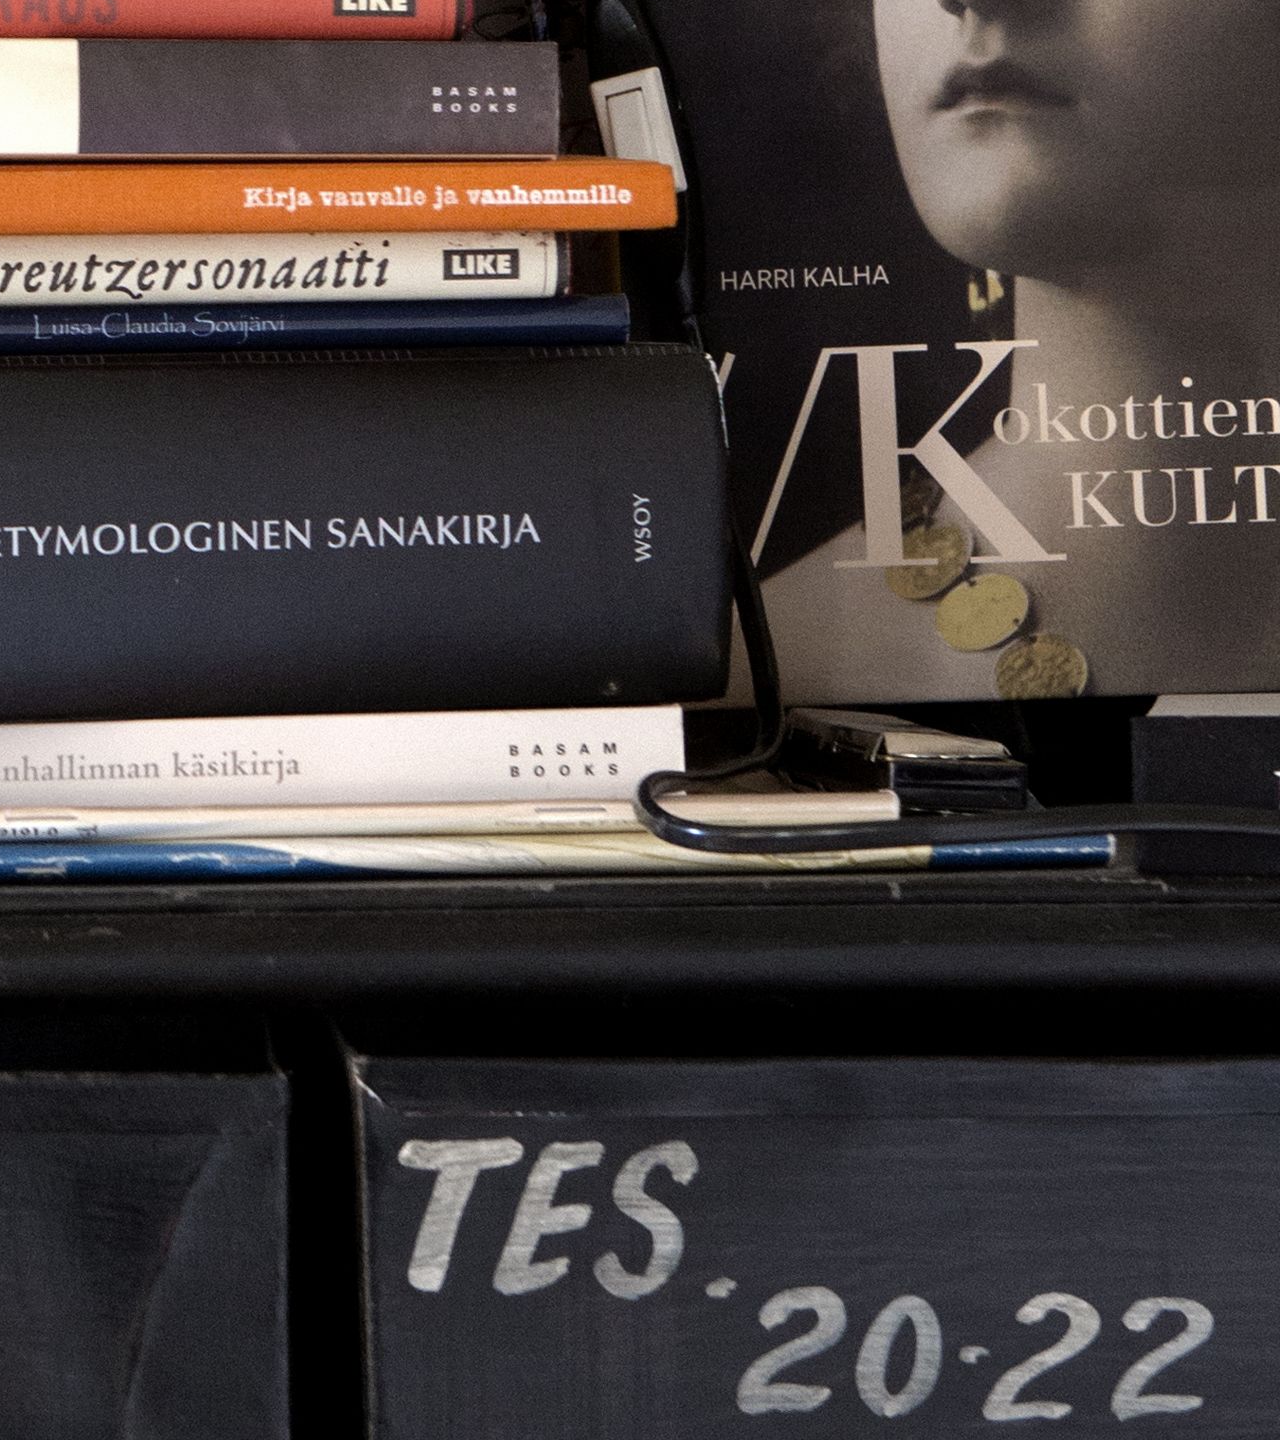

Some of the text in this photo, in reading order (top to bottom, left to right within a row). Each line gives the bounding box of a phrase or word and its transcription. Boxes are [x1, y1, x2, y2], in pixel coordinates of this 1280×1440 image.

[431, 86, 519, 99] BASAM
[431, 102, 519, 114] BOOKS
[243, 186, 315, 212] Kirja
[320, 185, 428, 208] vauvalle
[465, 184, 634, 207] vanhemmille
[450, 251, 514, 277] LIKE
[720, 265, 890, 292] HARRI KALHA
[32, 312, 187, 343] Luisa-Claudia
[192, 311, 287, 342] Sovijärvi
[326, 512, 542, 550] SANAKIRJA
[634, 493, 653, 564] WSOY
[508, 741, 620, 758] BASAM
[171, 750, 302, 786] käsikirja
[508, 761, 621, 779] BOOKS
[397, 1136, 739, 1300] TES.
